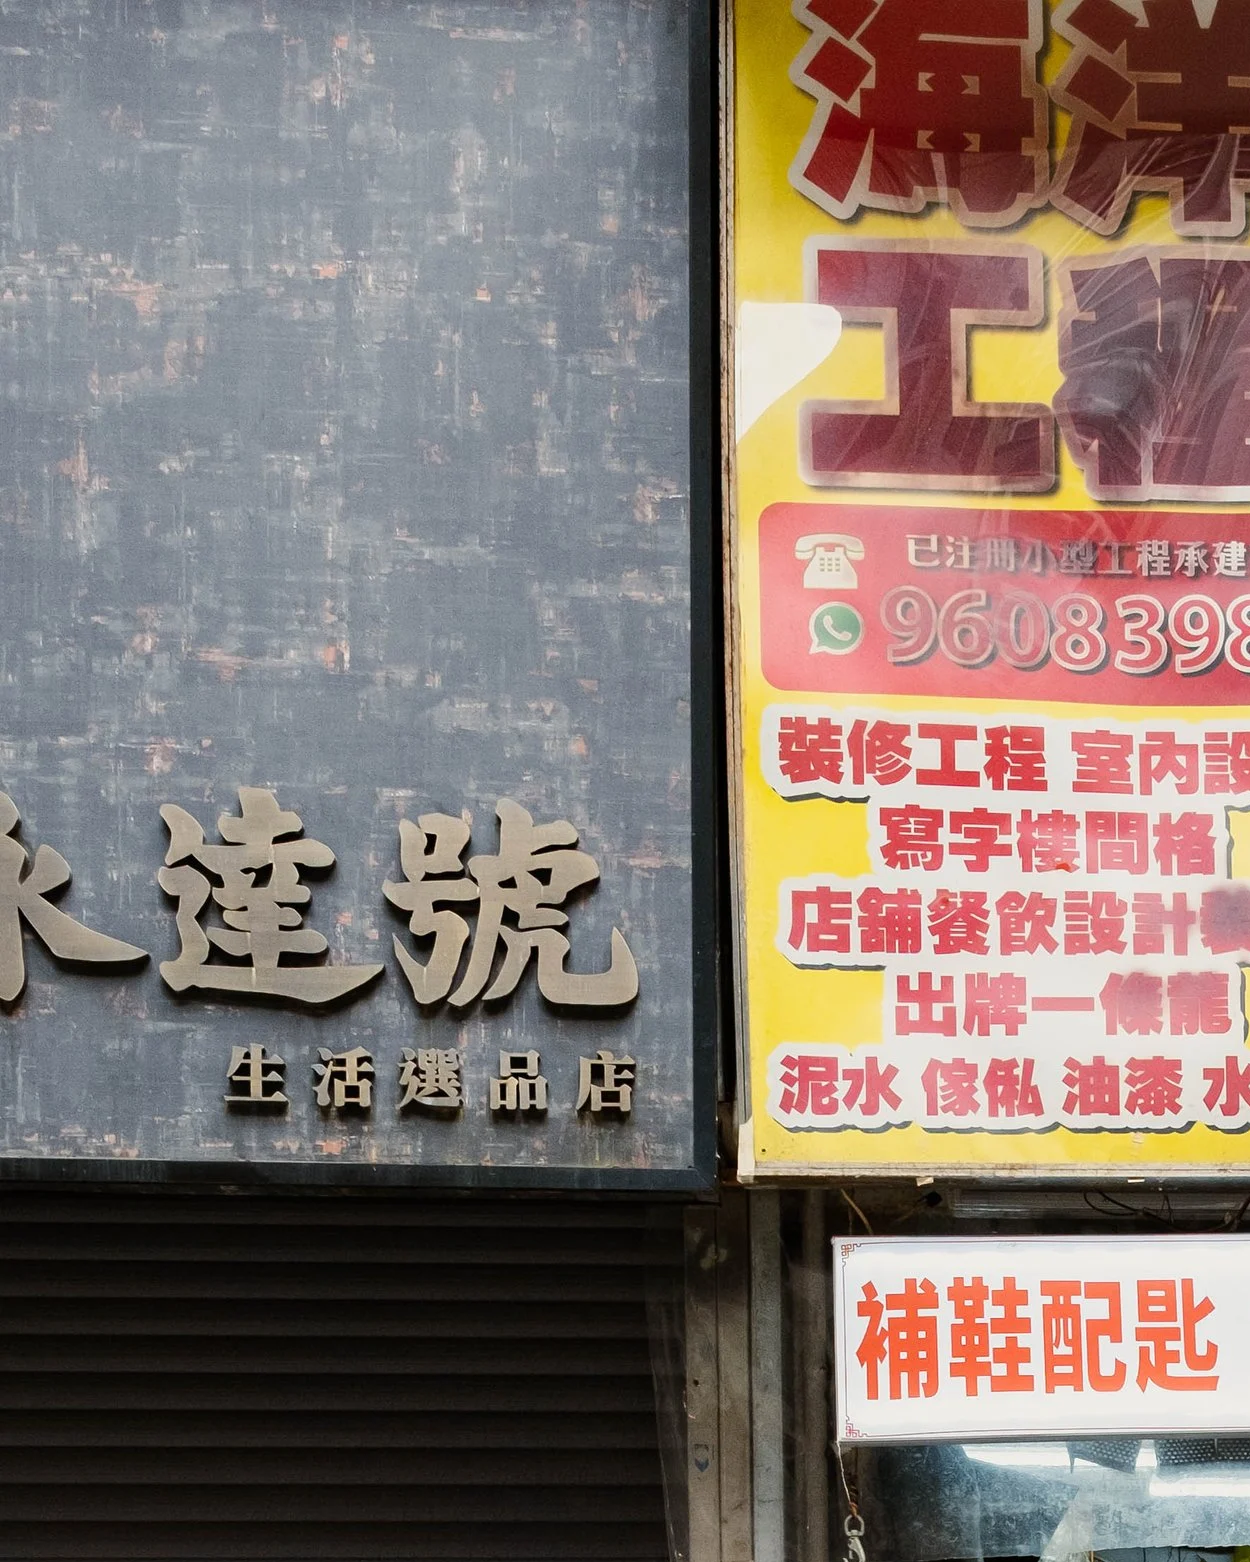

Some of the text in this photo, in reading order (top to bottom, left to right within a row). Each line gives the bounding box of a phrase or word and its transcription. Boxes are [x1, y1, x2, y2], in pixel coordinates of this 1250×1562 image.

[777, 716, 1049, 792] 裝修工程
[879, 804, 1216, 876] 寫字樓間格
[223, 1043, 637, 1112] 生活選品店
[778, 1053, 904, 1117] 泥水
[1061, 1055, 1185, 1118] 油漆
[855, 1278, 1220, 1402] 補鞋配匙
